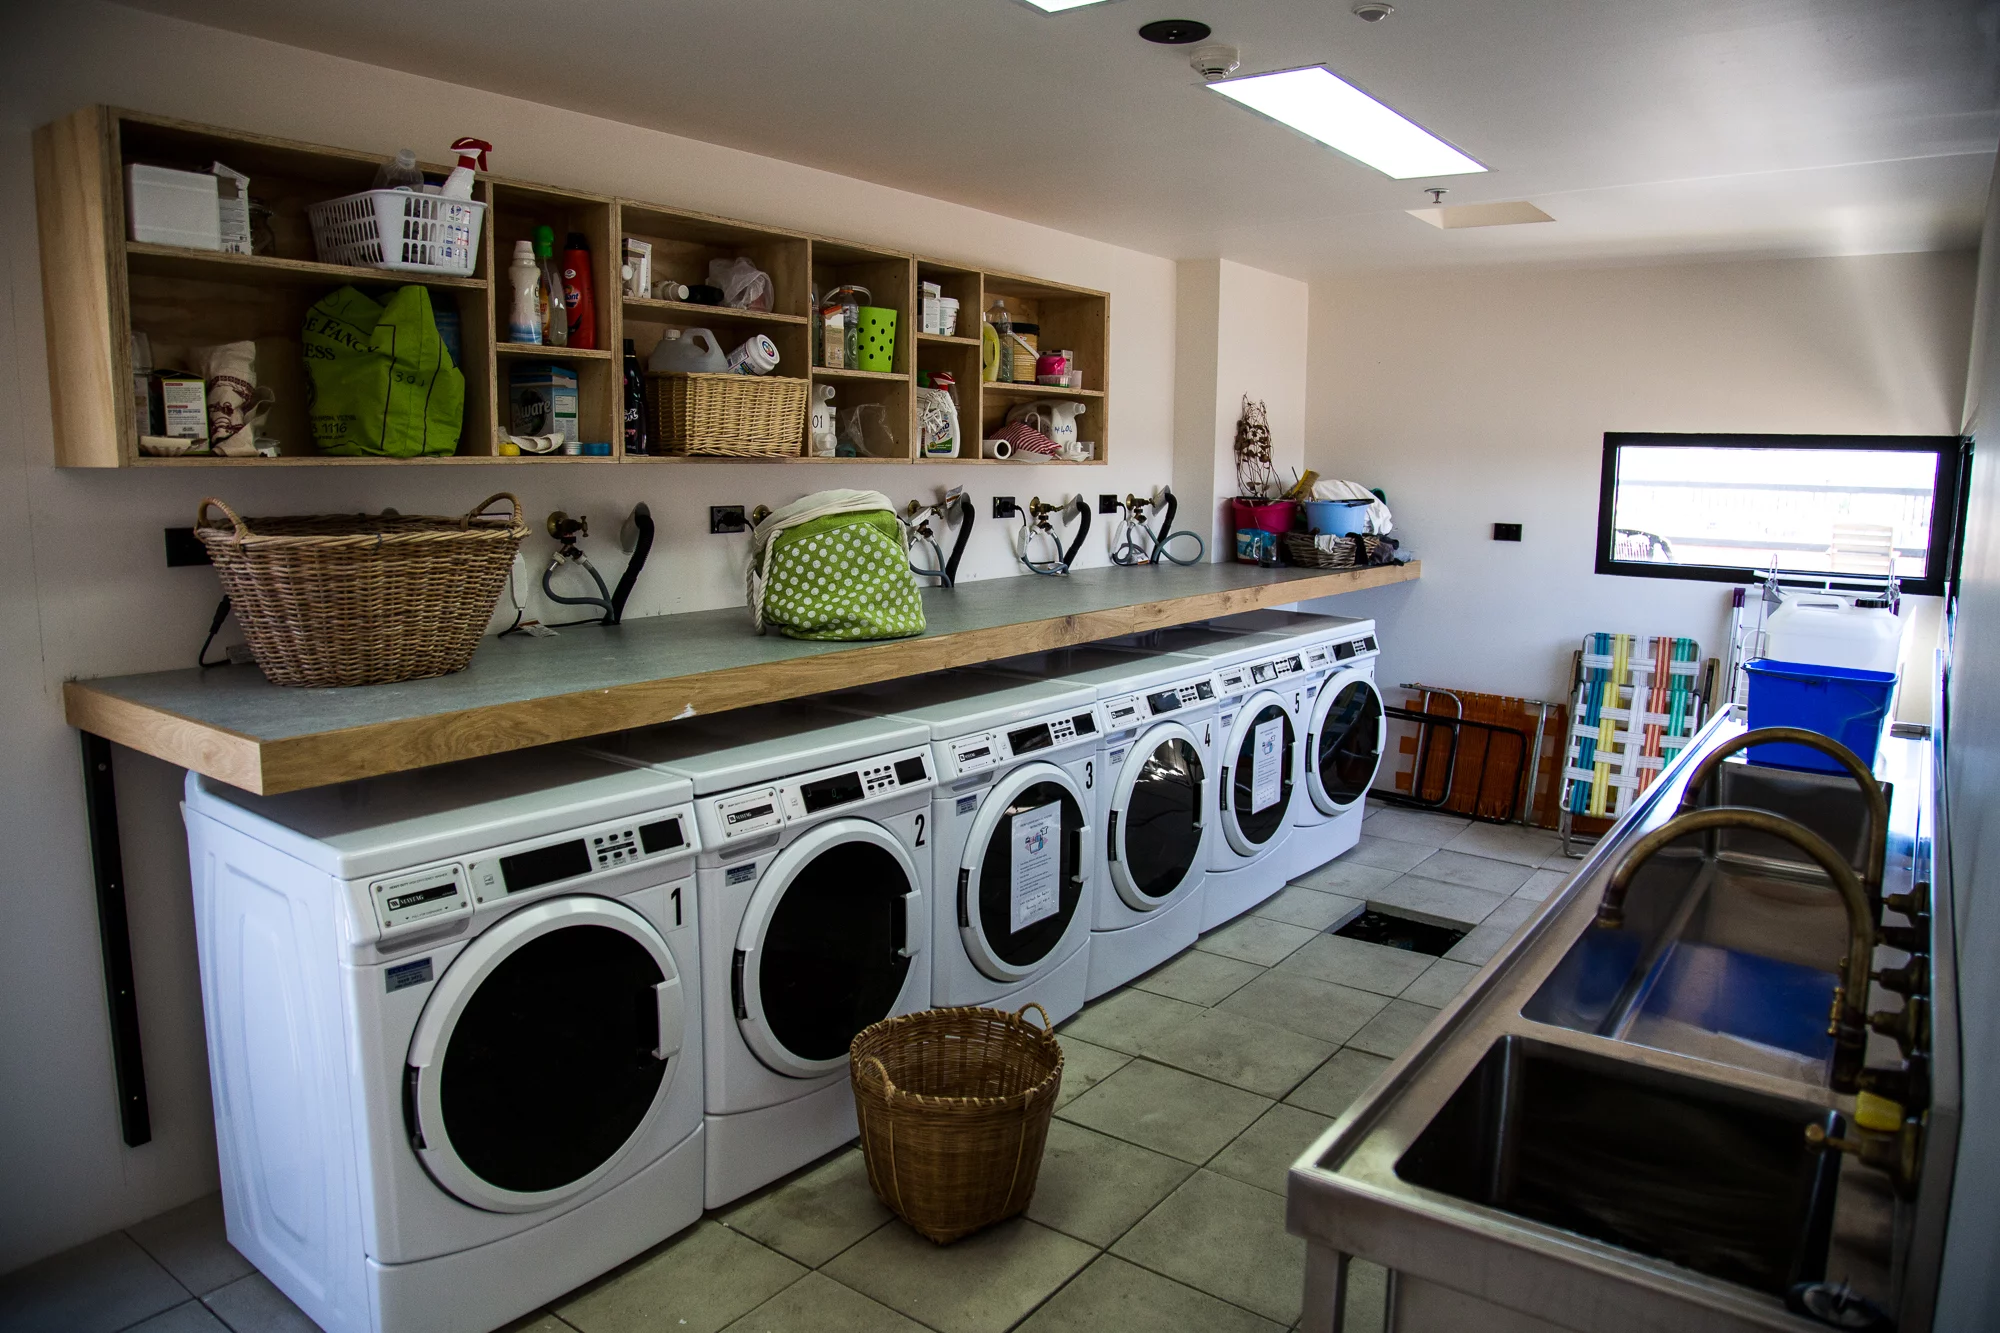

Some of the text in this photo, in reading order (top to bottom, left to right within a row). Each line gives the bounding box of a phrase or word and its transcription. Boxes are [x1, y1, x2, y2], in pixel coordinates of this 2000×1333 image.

[304, 343, 336, 361] ESS
[1294, 692, 1300, 715] 5
[1204, 723, 1211, 748] 4
[1085, 761, 1094, 789] 3
[914, 813, 926, 847] 2
[670, 887, 682, 926] 1
